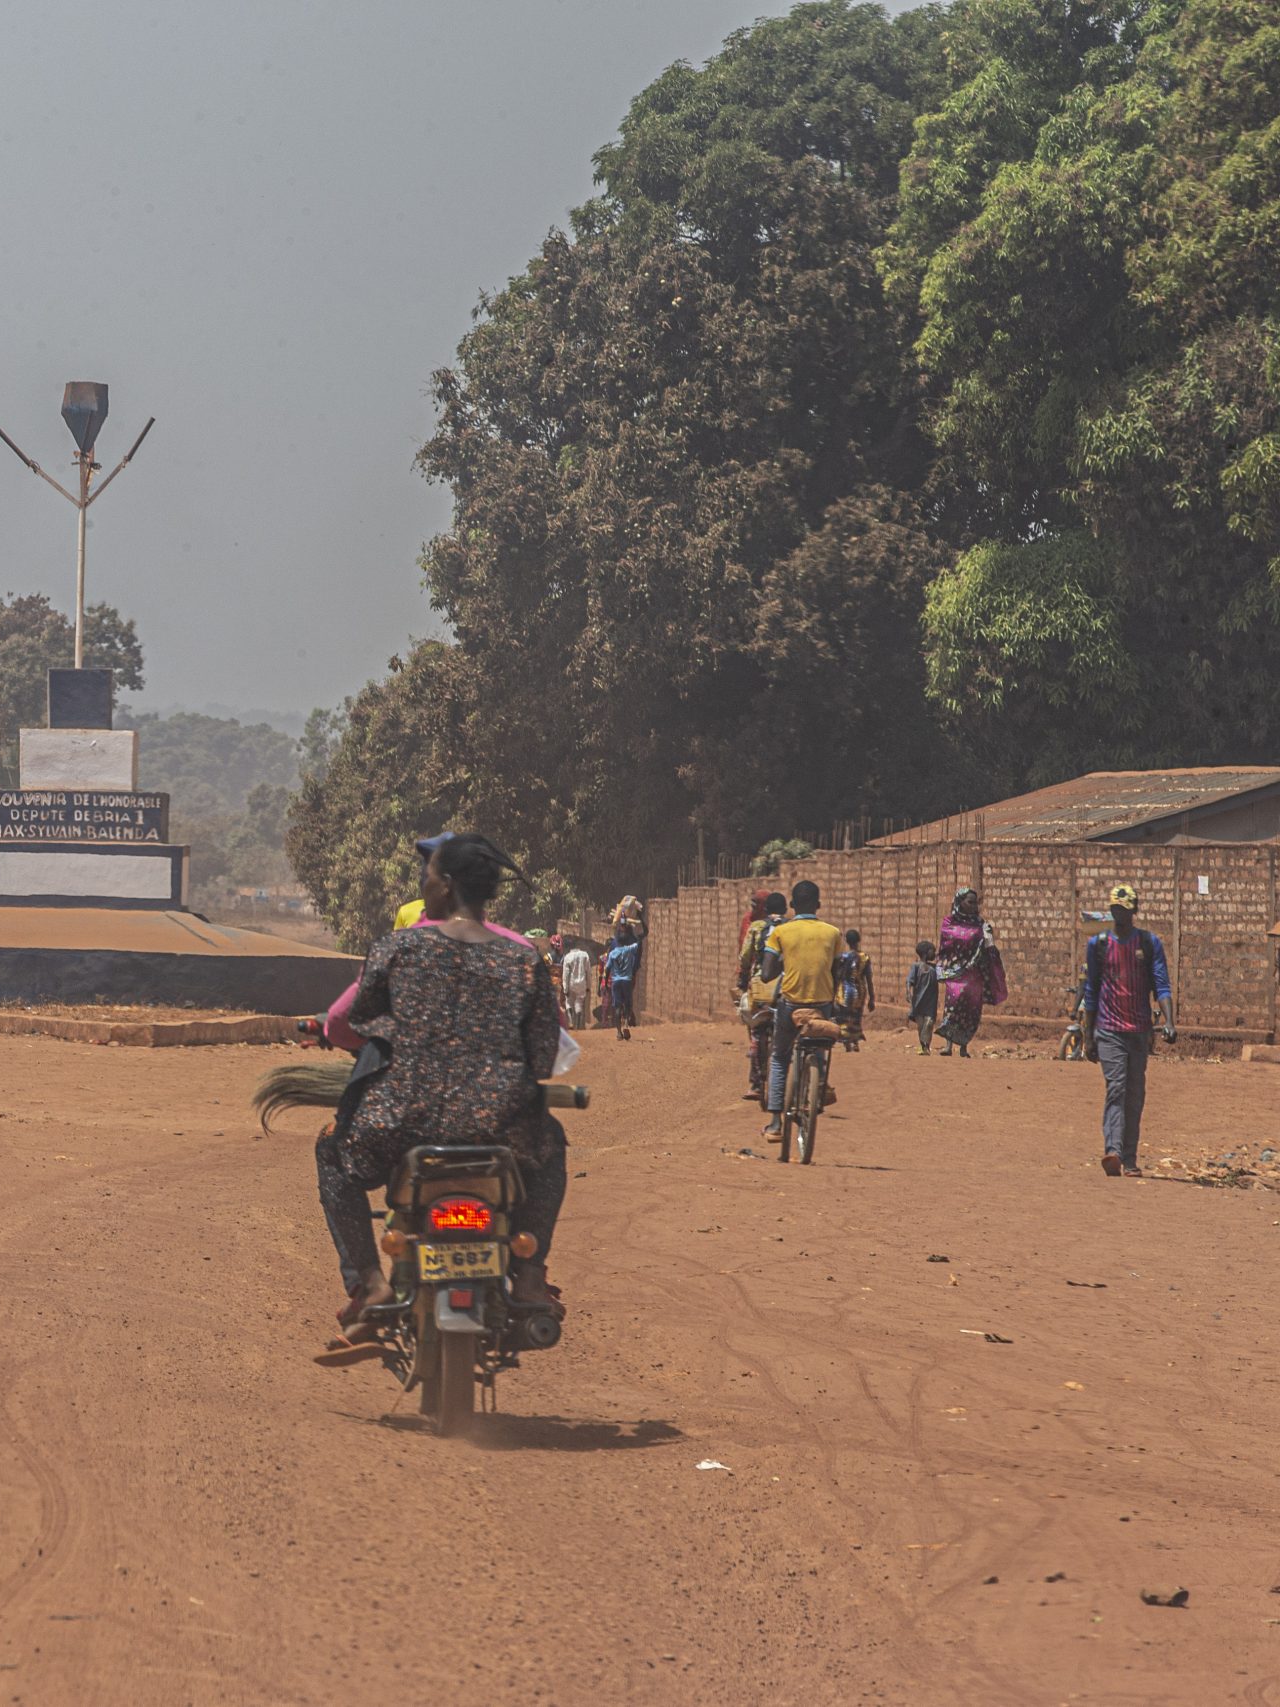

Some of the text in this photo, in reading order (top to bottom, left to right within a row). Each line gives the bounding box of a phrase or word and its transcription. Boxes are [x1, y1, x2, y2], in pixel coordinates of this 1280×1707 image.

[74, 793, 90, 806] DE
[10, 809, 67, 822] DEPUTE
[74, 809, 90, 822] DE
[93, 811, 132, 823] BRIA
